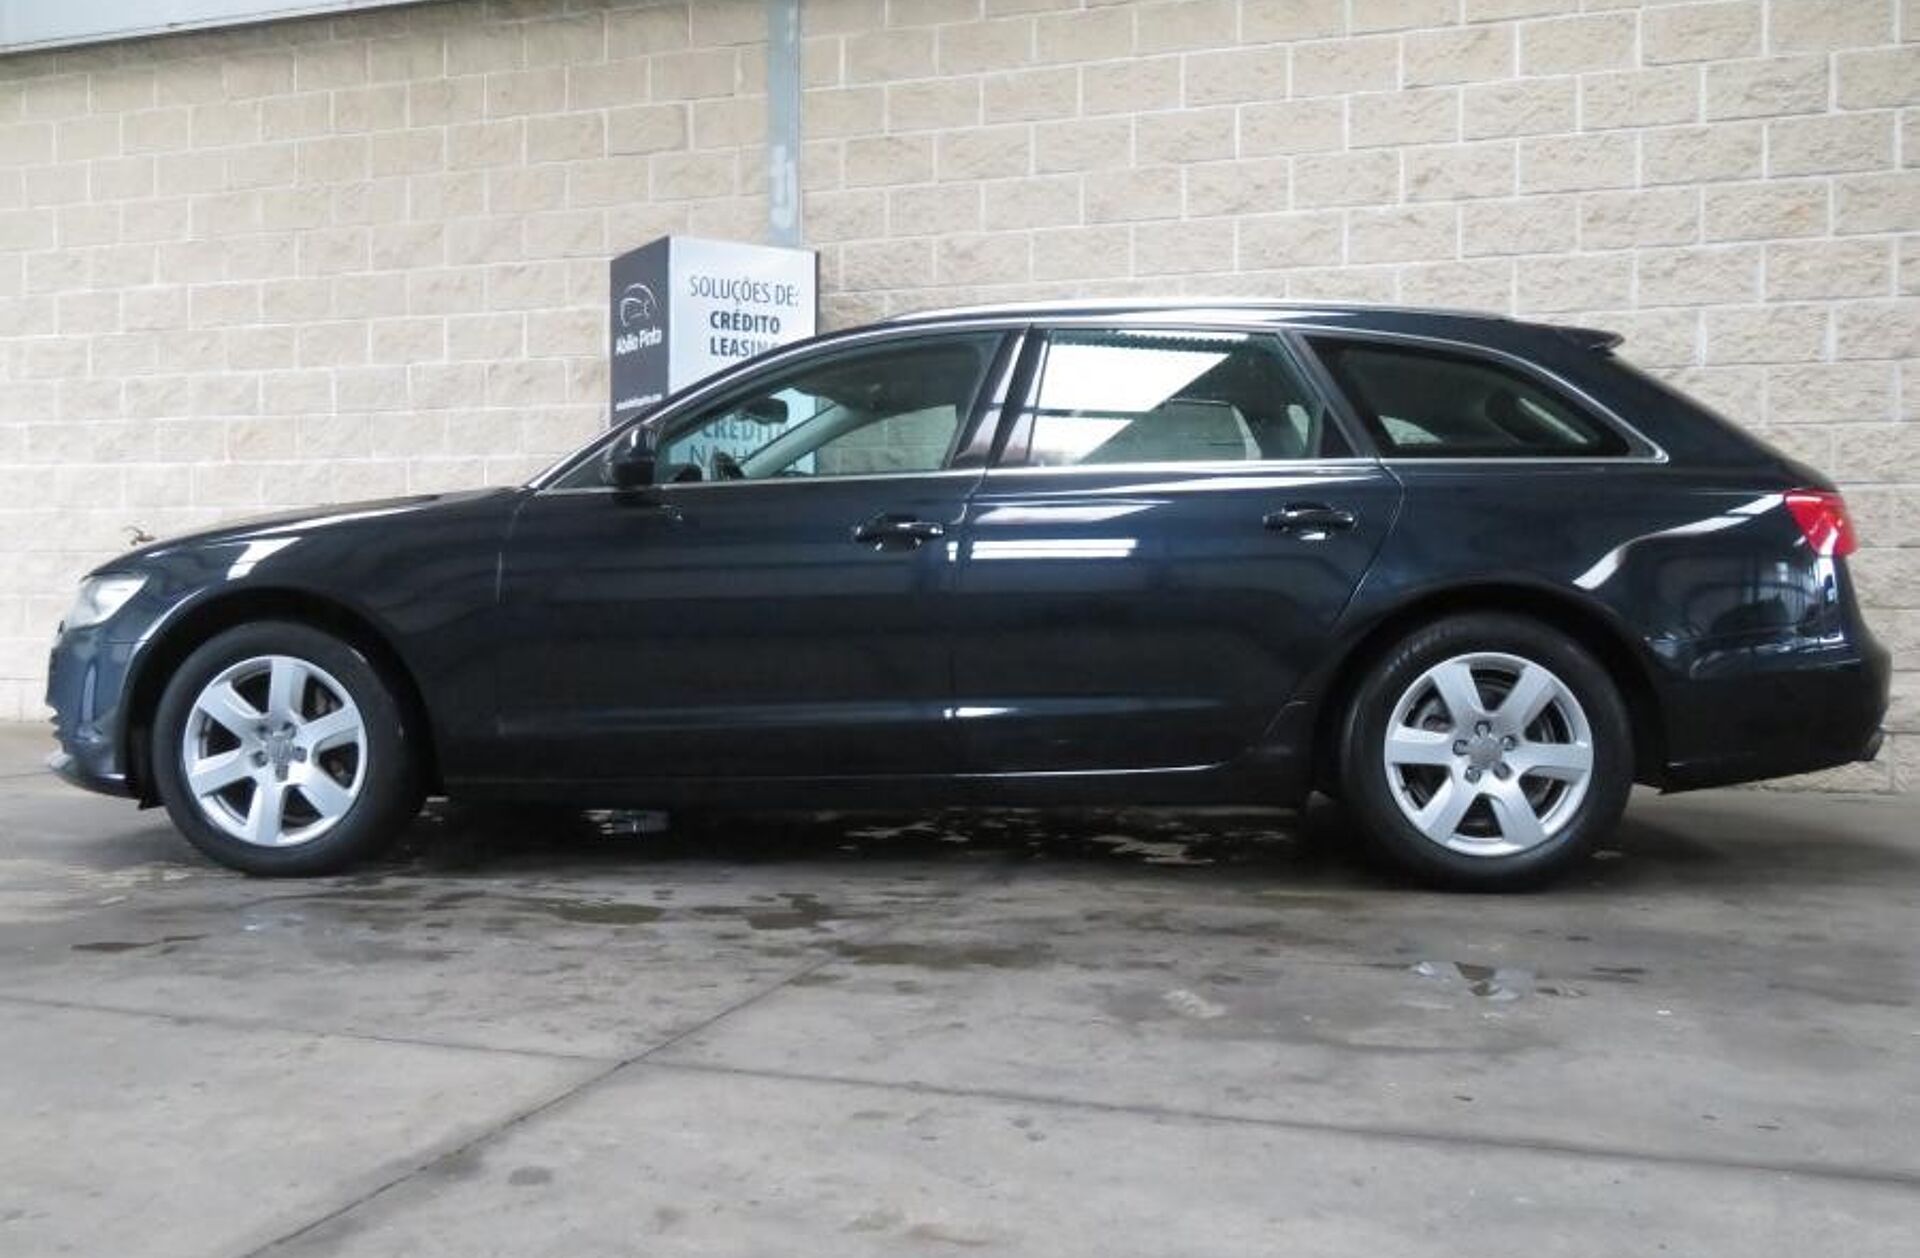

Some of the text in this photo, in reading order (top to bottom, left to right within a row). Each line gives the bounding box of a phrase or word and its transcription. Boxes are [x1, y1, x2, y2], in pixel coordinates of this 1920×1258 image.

[690, 276, 799, 307] SOLUÇÕES DE:
[710, 309, 780, 334] CRÉDITO
